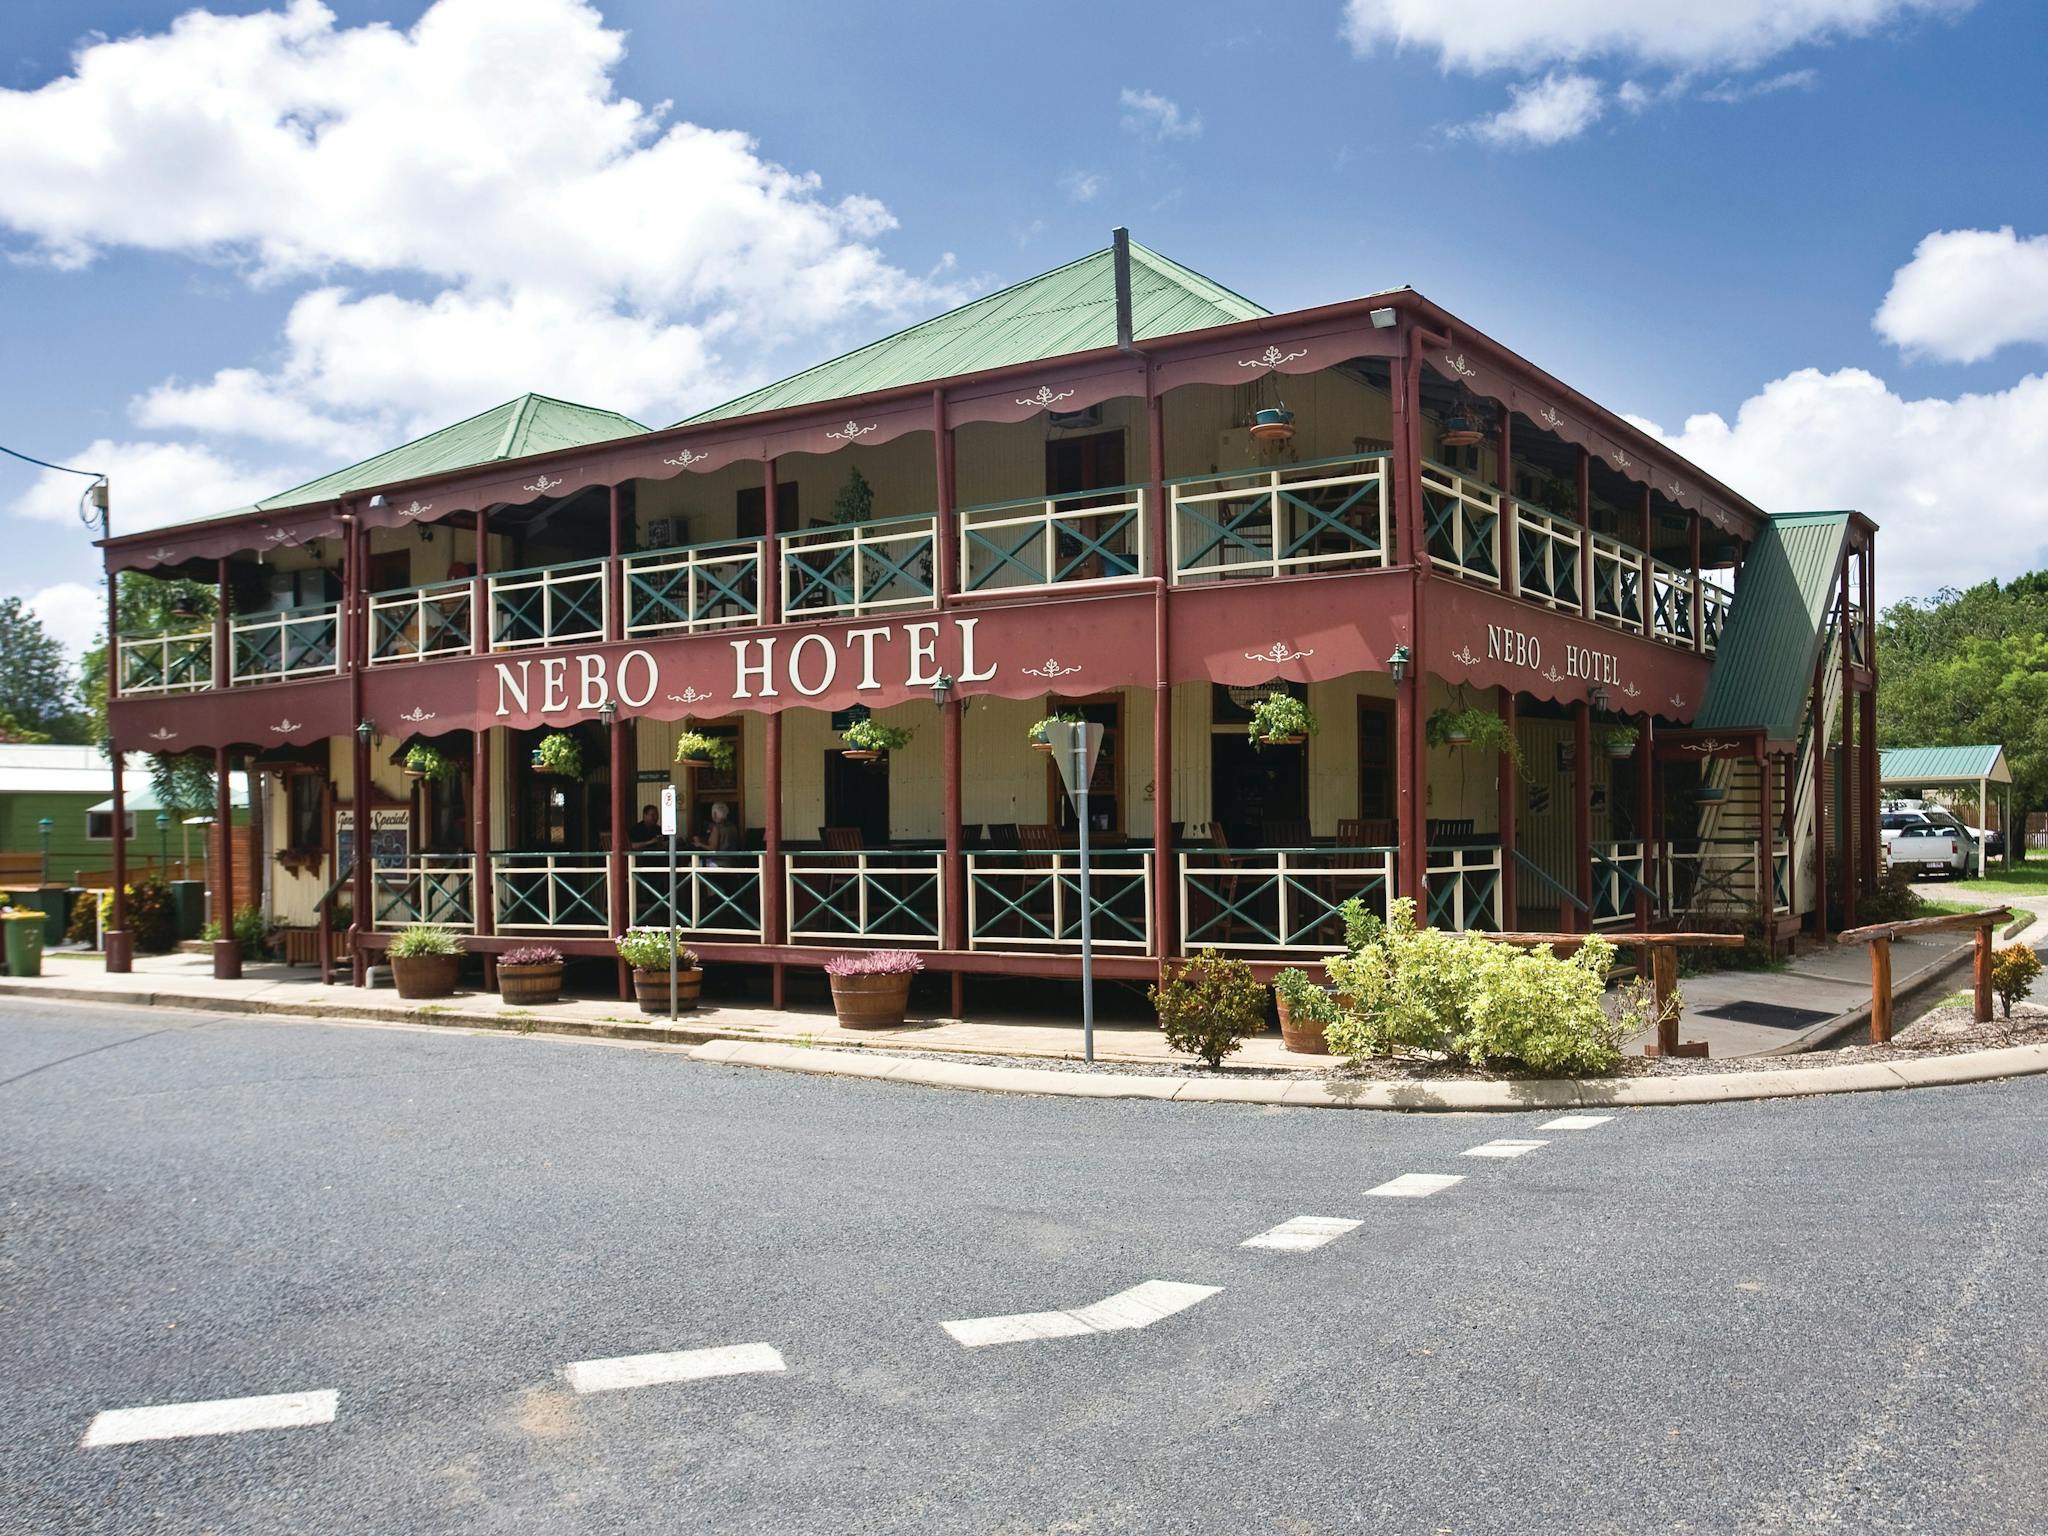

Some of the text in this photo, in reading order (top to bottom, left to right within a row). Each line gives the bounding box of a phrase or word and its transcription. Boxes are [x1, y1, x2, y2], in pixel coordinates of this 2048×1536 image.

[495, 618, 998, 716] NEBO HOTEL
[1487, 623, 1621, 686] NEBO HOTEL
[374, 811, 409, 831] Specials
